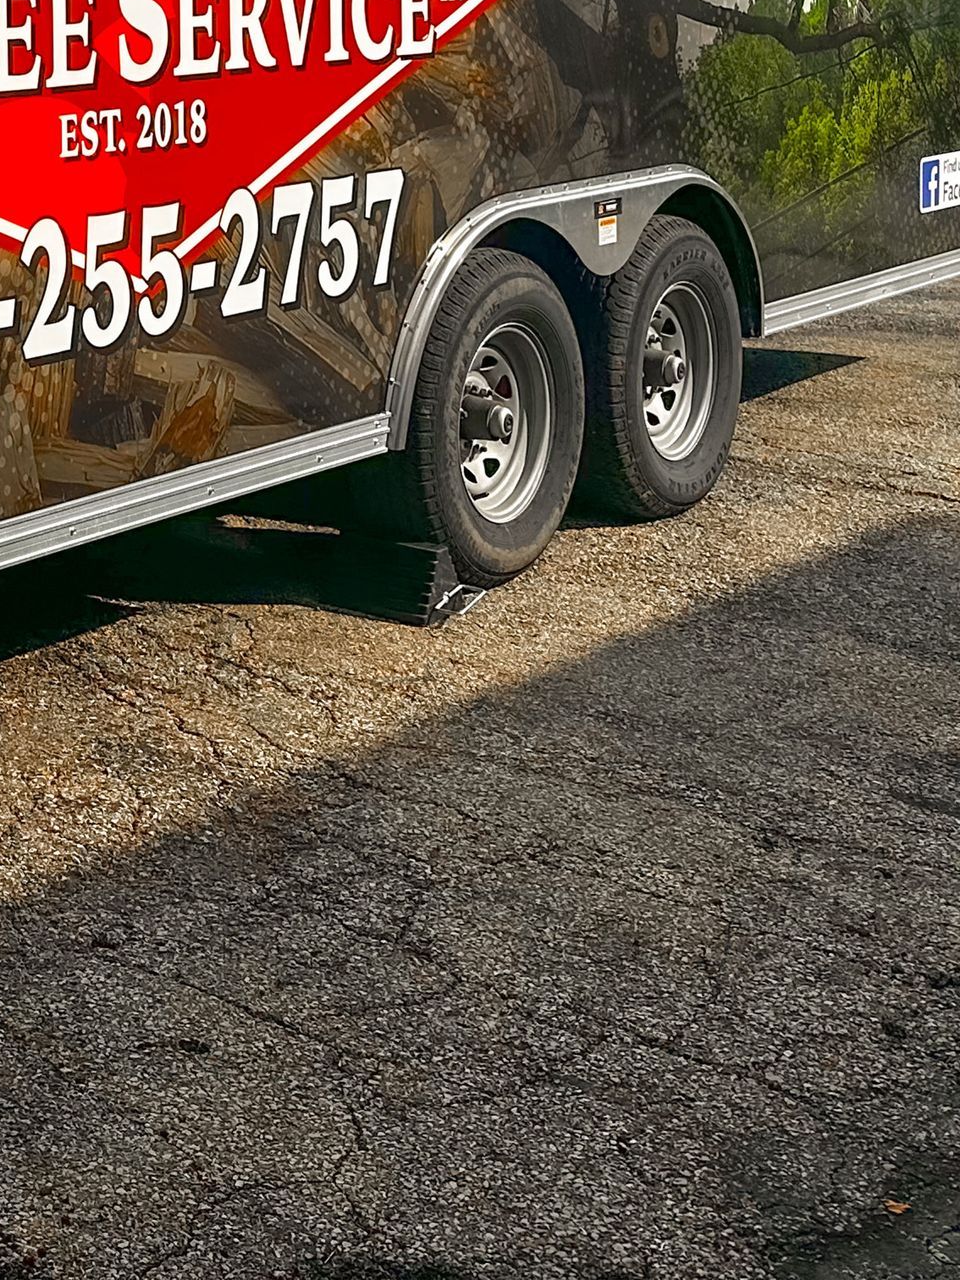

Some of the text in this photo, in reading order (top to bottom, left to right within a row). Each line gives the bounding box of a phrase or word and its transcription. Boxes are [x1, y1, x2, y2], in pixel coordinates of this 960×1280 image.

[59, 99, 208, 159] EST. 2018
[943, 158, 957, 174] Find
[943, 181, 960, 202] Fac
